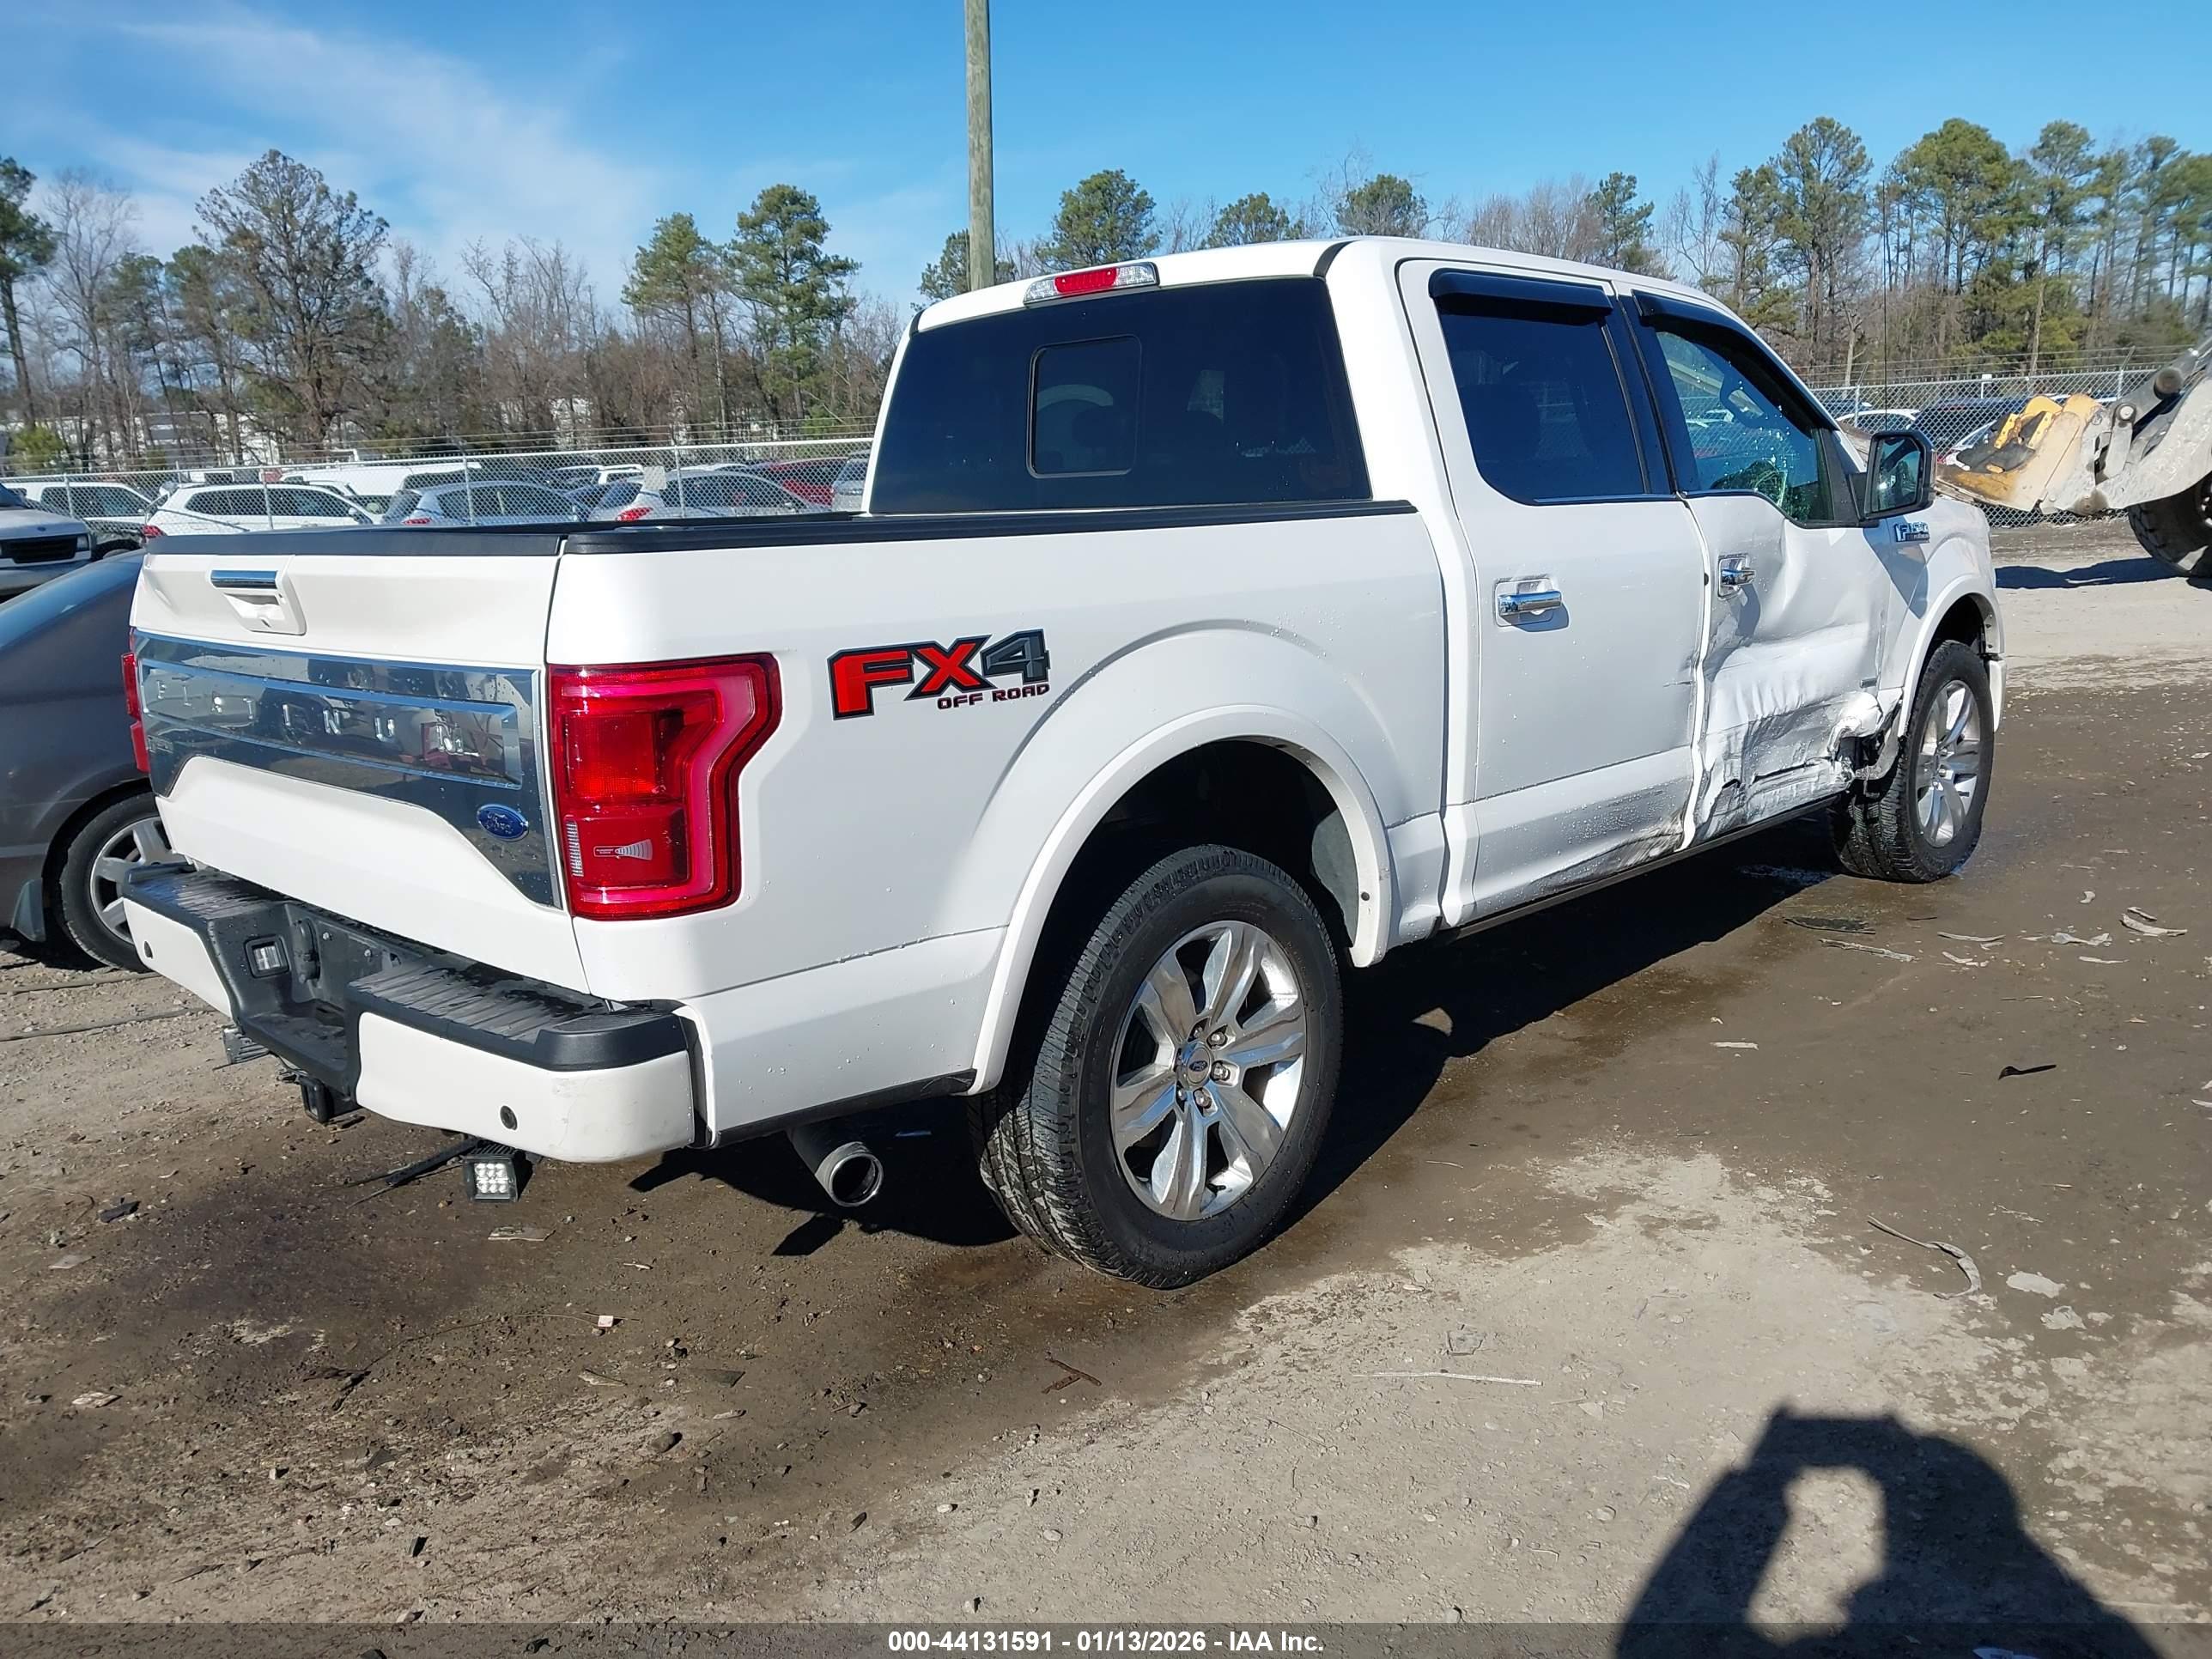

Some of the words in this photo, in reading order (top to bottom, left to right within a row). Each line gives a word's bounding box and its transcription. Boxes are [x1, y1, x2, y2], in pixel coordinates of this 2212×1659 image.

[827, 629, 1051, 720] FX4
[937, 692, 983, 709] OFF
[992, 683, 1050, 702] ROAD
